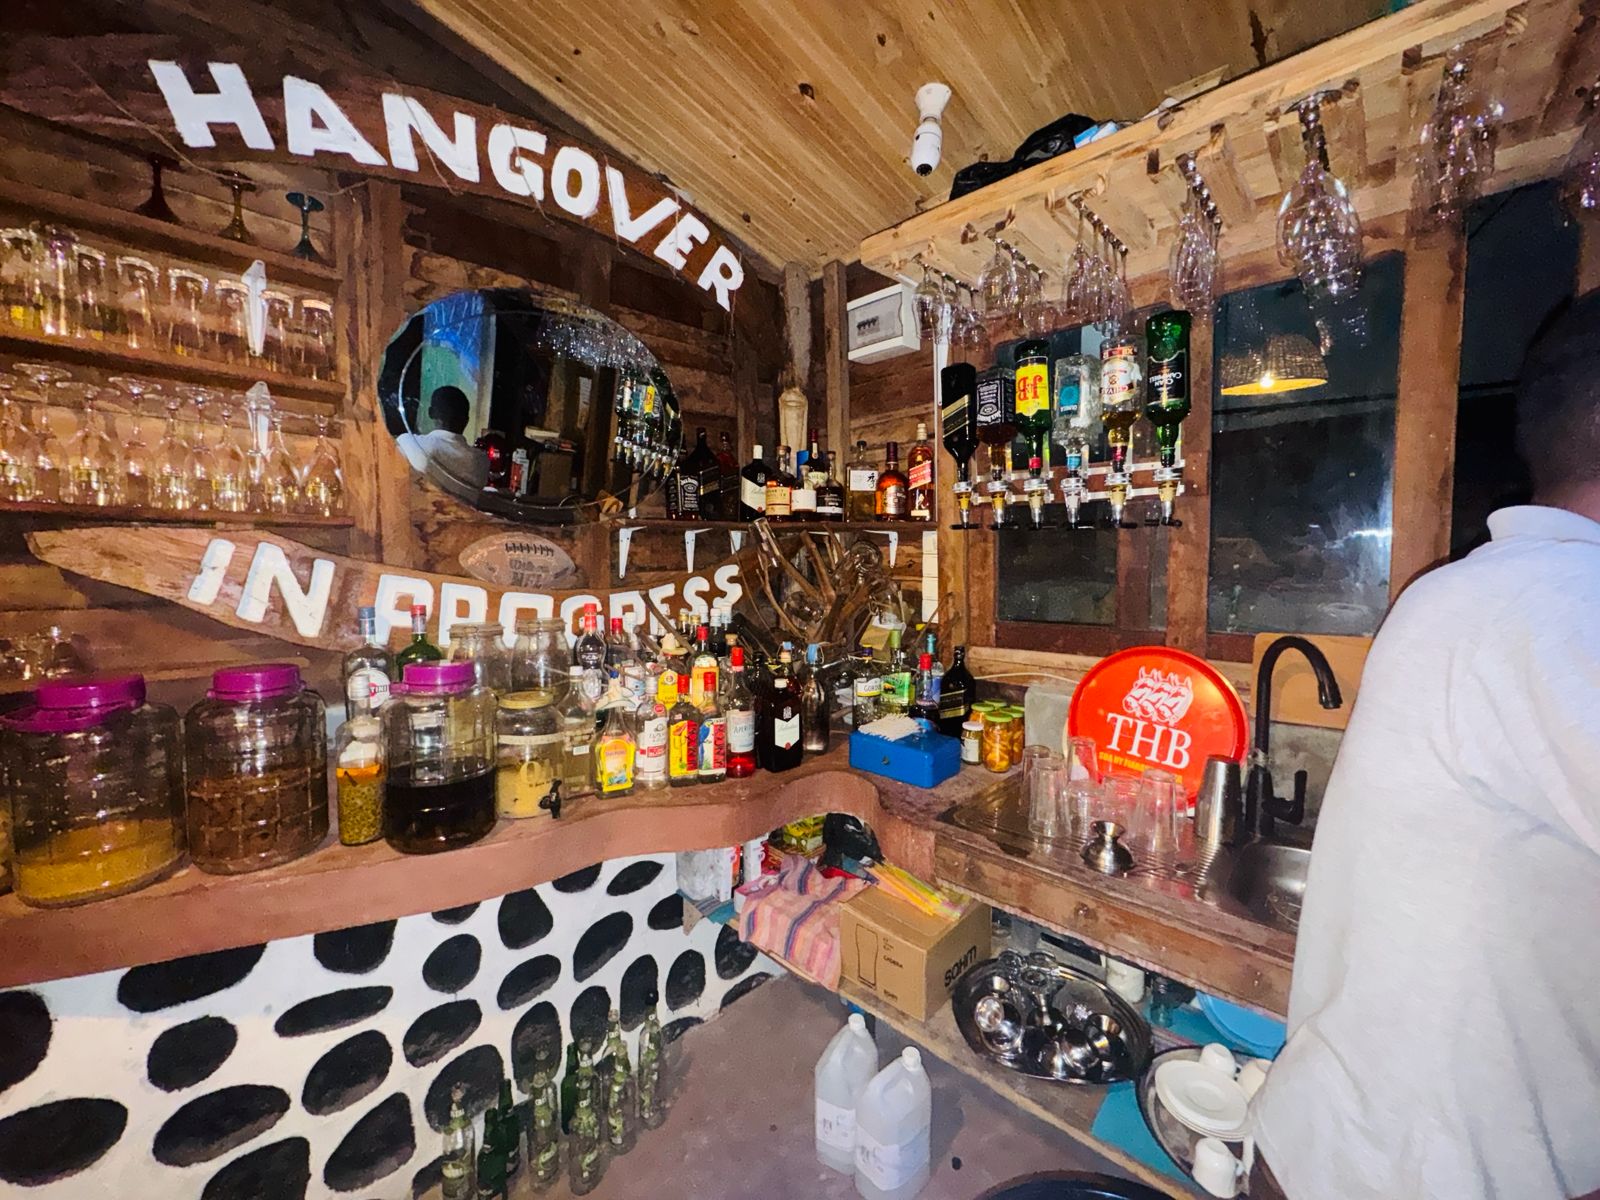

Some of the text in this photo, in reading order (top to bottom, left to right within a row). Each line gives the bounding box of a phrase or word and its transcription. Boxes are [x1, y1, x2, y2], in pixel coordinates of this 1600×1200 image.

[147, 59, 745, 312] HANGOVER
[187, 537, 337, 639] IN
[1106, 712, 1192, 770] THB
